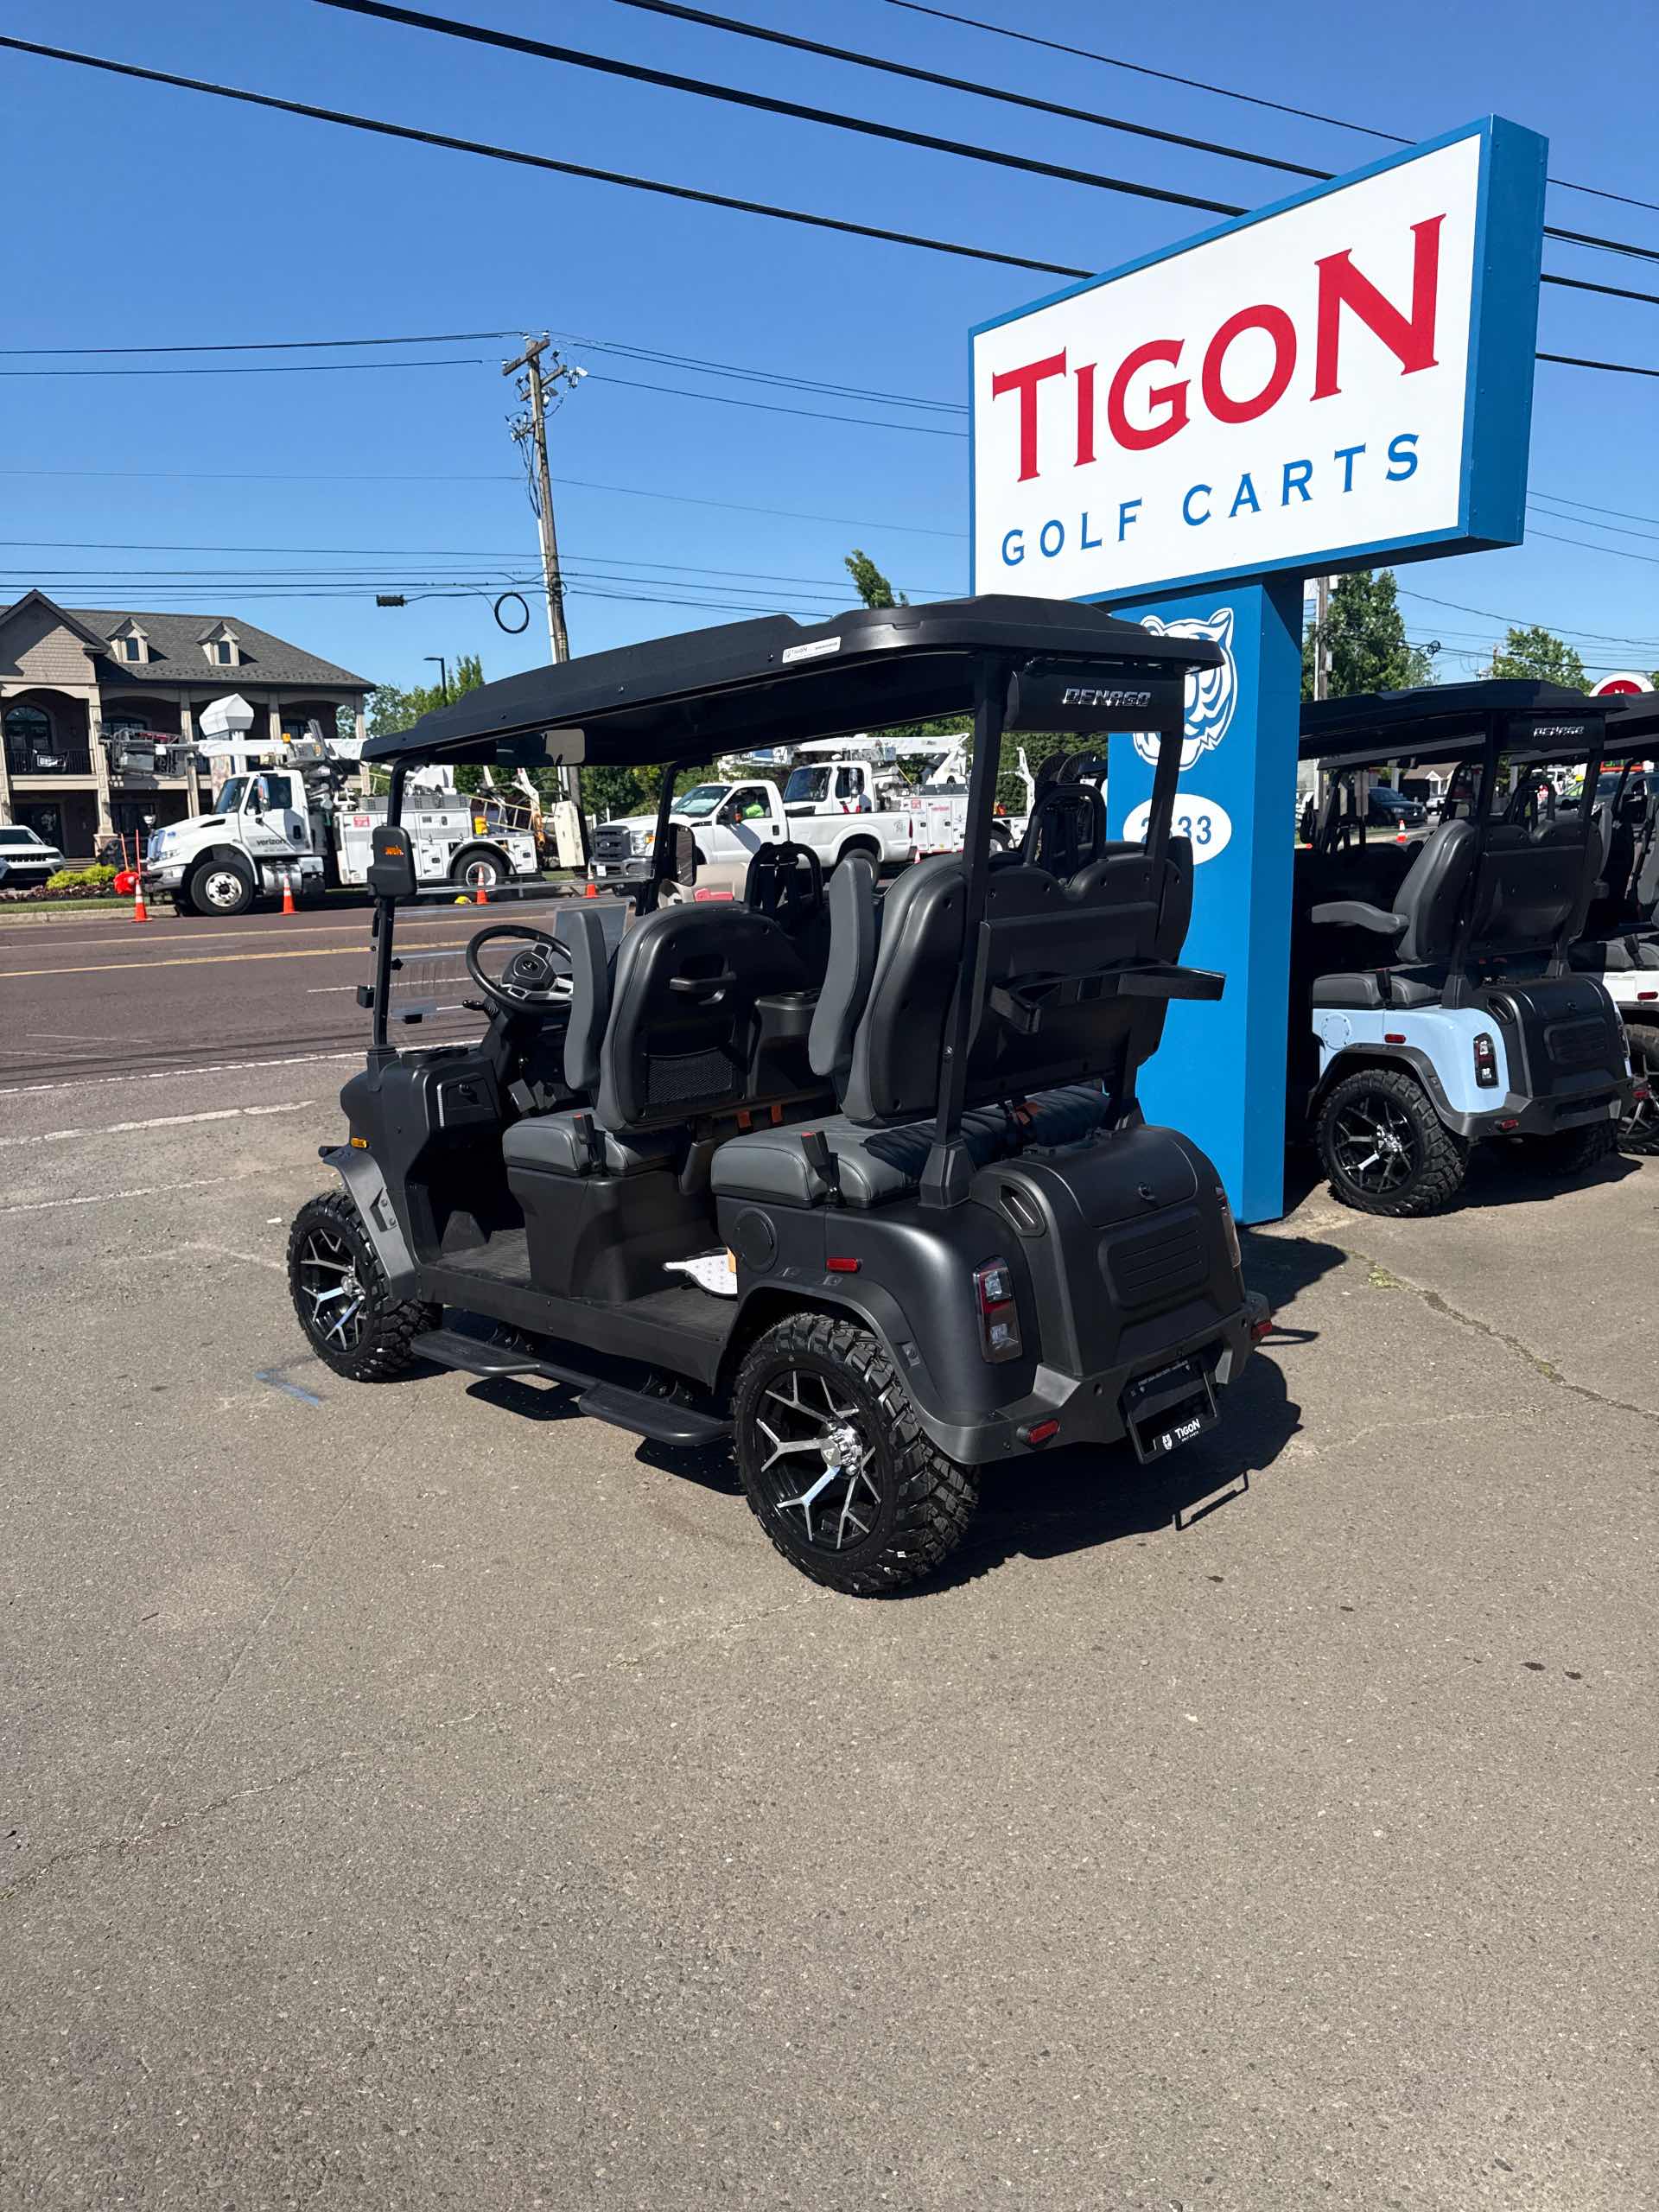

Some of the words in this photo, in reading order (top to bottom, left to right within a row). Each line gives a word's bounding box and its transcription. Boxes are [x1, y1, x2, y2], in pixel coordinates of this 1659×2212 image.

[992, 213, 1446, 482] TIGON
[1001, 497, 1142, 566] GOLF
[1182, 433, 1419, 525] CARTS
[1063, 688, 1151, 707] DENAGO
[1141, 815, 1211, 845] 233
[1174, 1418, 1200, 1439] TIGON
